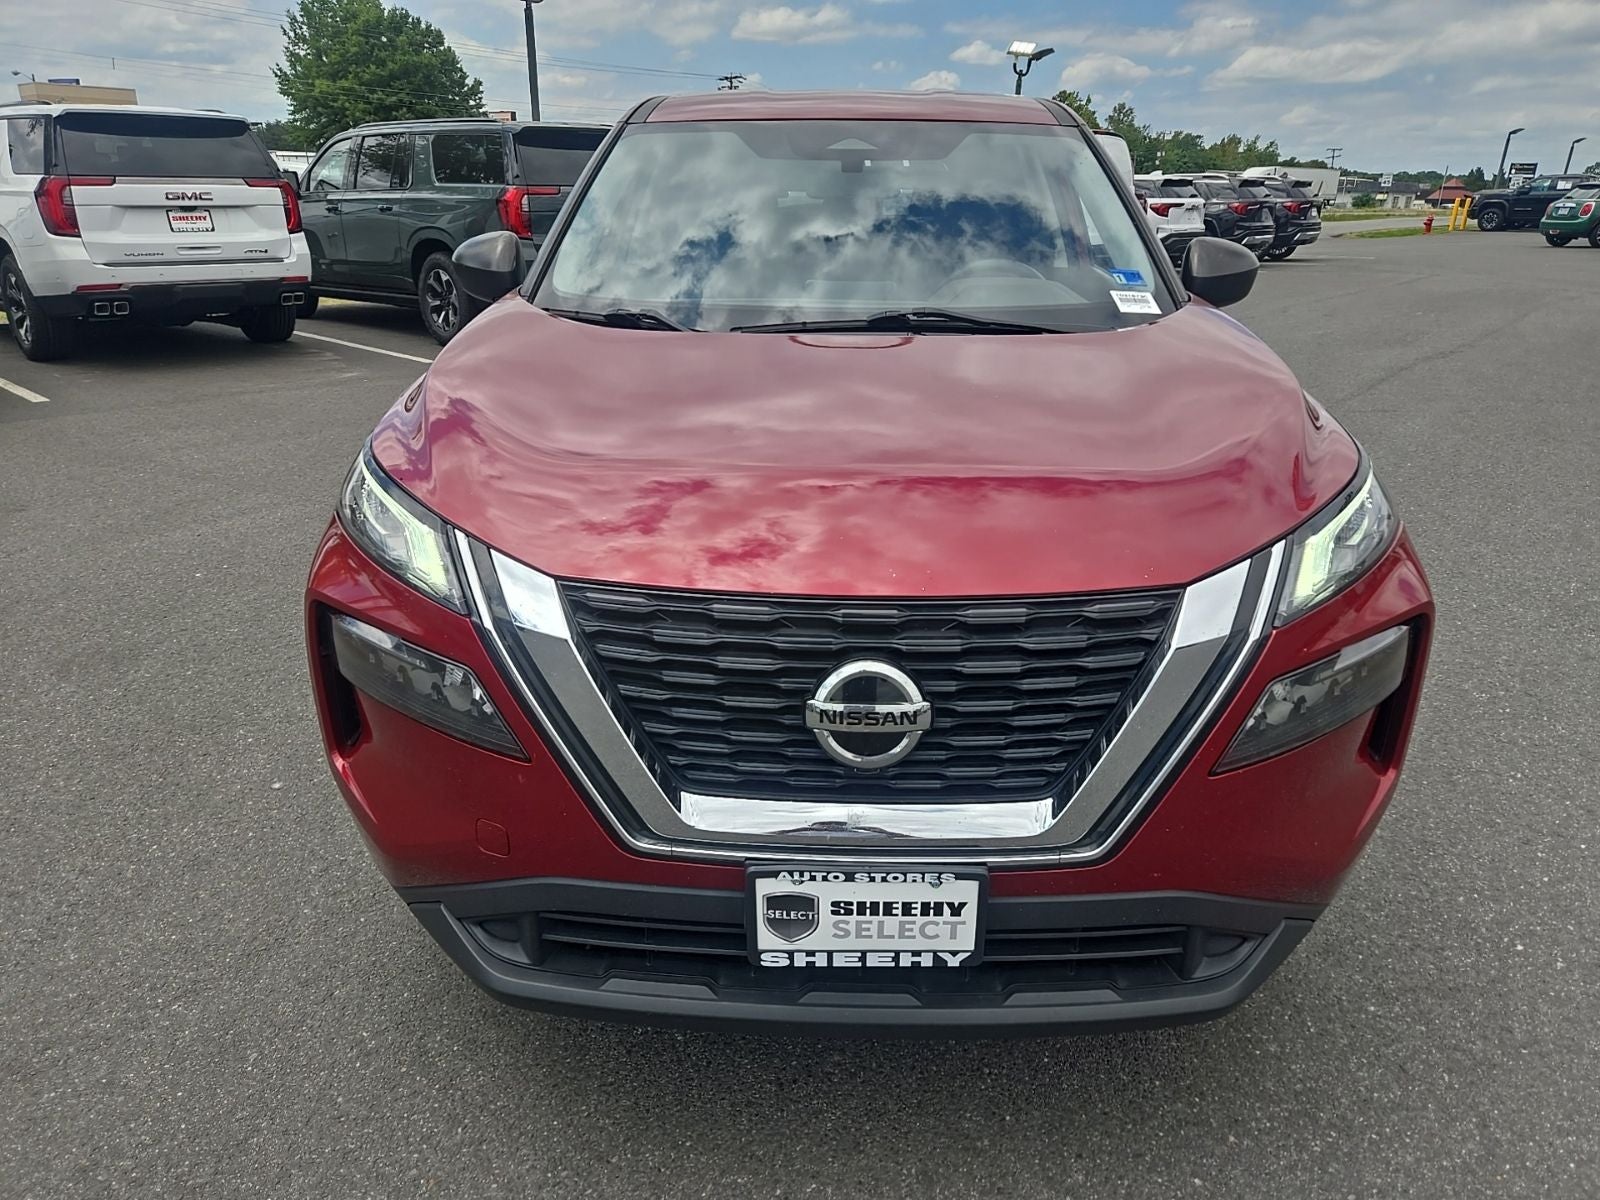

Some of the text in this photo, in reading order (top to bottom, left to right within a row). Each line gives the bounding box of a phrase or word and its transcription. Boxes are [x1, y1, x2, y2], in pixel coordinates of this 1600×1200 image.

[165, 191, 213, 201] GMC
[818, 709, 918, 727] NISSAN
[775, 871, 956, 883] AUTO STORES
[766, 909, 815, 921] SELECT
[829, 900, 969, 918] SHEEHY
[831, 920, 967, 940] SELECT
[759, 951, 973, 968] SHEEHY
